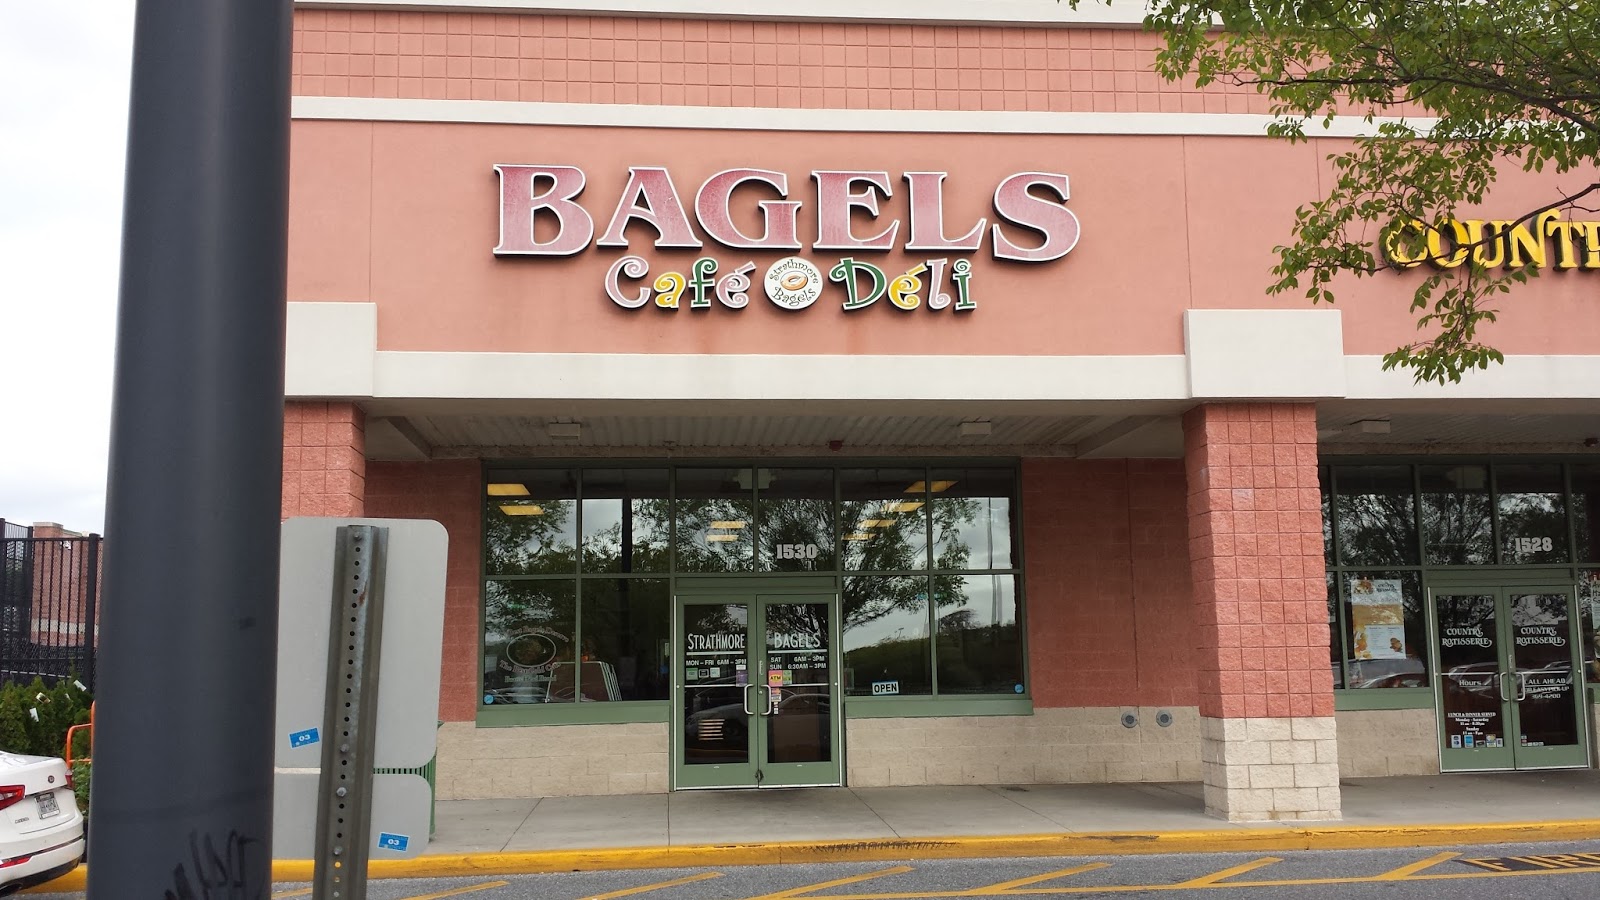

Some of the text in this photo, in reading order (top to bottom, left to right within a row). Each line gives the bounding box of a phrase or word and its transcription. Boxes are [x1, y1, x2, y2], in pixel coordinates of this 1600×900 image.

[493, 164, 1081, 262] BAGELS
[769, 258, 819, 284] Strathmore
[604, 255, 757, 310] Café
[828, 256, 978, 311] Déli
[771, 288, 817, 307] Bagels
[1514, 536, 1553, 552] 1528
[776, 543, 818, 560] 1530
[1446, 627, 1484, 637] COUNTRY
[1520, 626, 1558, 636] COUNTRY
[688, 633, 746, 649] STRATHMORE
[774, 632, 821, 648] BAGELS
[1441, 637, 1493, 648] ROTISSERIE
[1515, 636, 1566, 647] ROTISSERIE
[685, 659, 700, 667] MON
[716, 658, 730, 666] 6AM
[812, 654, 825, 662] 3PM
[1542, 677, 1566, 685] AHEAD
[873, 684, 898, 694] OPEN
[298, 734, 311, 742] 03
